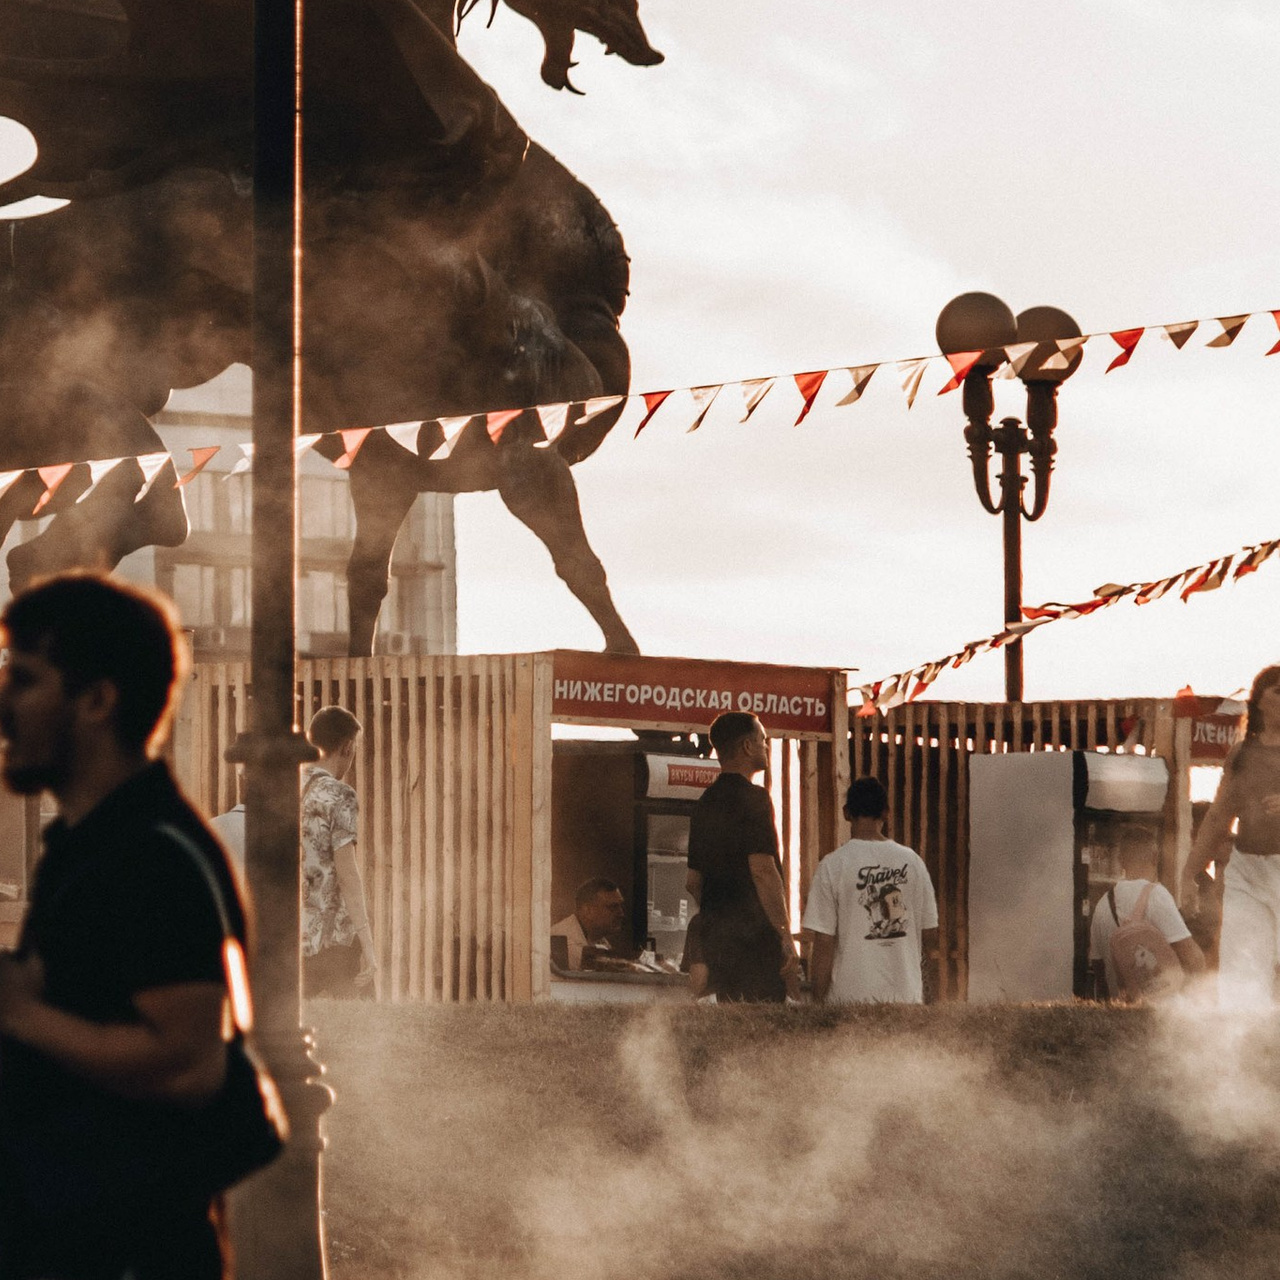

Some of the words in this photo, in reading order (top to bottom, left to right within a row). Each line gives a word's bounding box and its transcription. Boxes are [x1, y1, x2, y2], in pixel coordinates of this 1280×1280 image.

[555, 680, 732, 711] НИЖЕГОРОДСКАЯ
[738, 692, 826, 717] ОБЛАСТЬ
[695, 770, 720, 784] РОССИ
[856, 864, 908, 890] Travel
